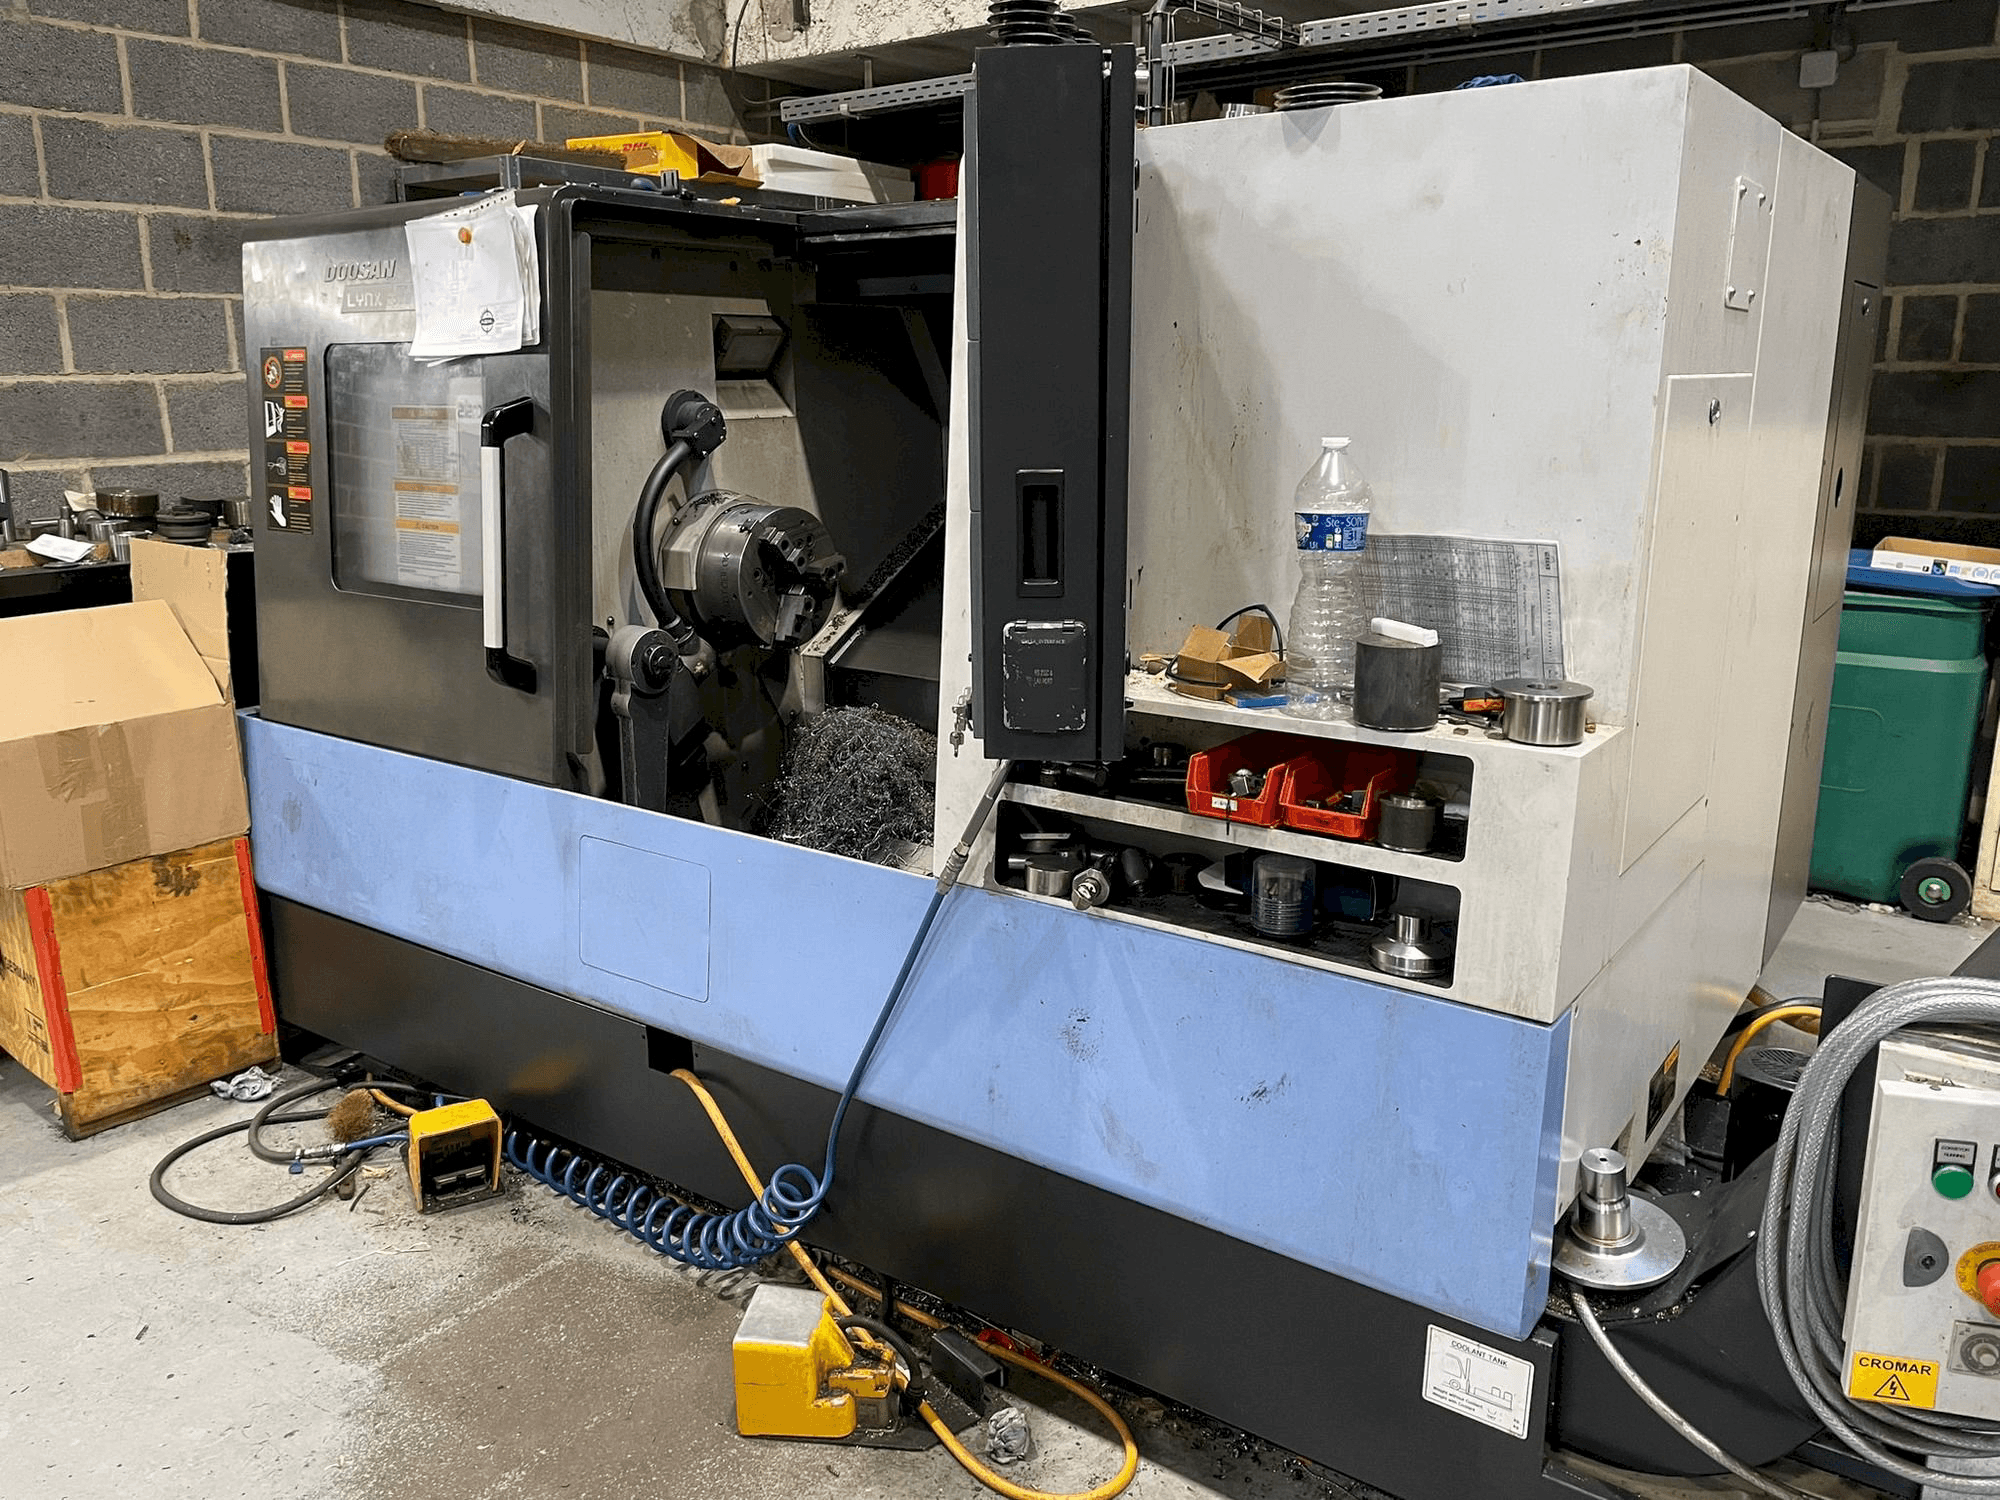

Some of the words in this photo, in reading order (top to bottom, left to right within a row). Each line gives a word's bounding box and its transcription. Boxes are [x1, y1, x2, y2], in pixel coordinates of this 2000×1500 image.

[323, 259, 397, 283] DOOSAN
[1451, 1340, 1486, 1357] COOLANT
[1489, 1354, 1508, 1366] TANK
[1859, 1357, 1932, 1376] CROMAR
